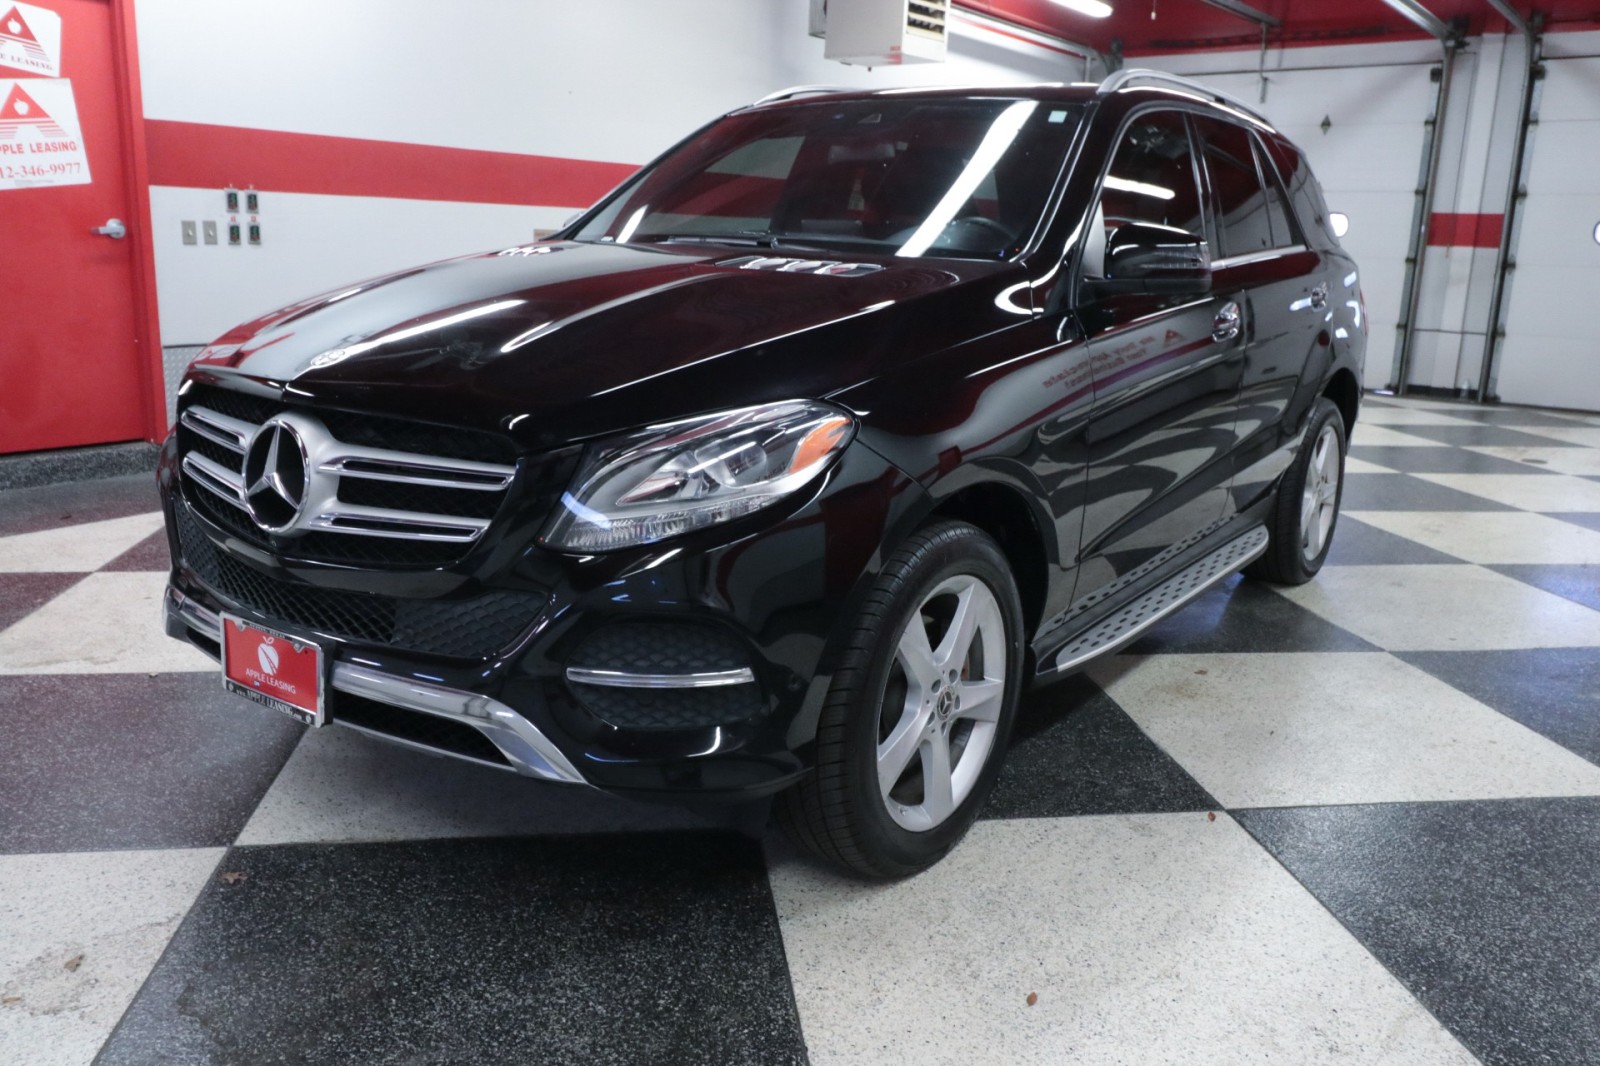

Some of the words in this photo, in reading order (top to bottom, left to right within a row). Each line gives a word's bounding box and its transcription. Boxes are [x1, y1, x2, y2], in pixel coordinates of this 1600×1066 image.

[11, 55, 53, 70] LEASING
[0, 143, 24, 154] PLE
[29, 141, 77, 153] LEASING
[245, 668, 266, 683] APPLE
[266, 676, 296, 694] LEASING
